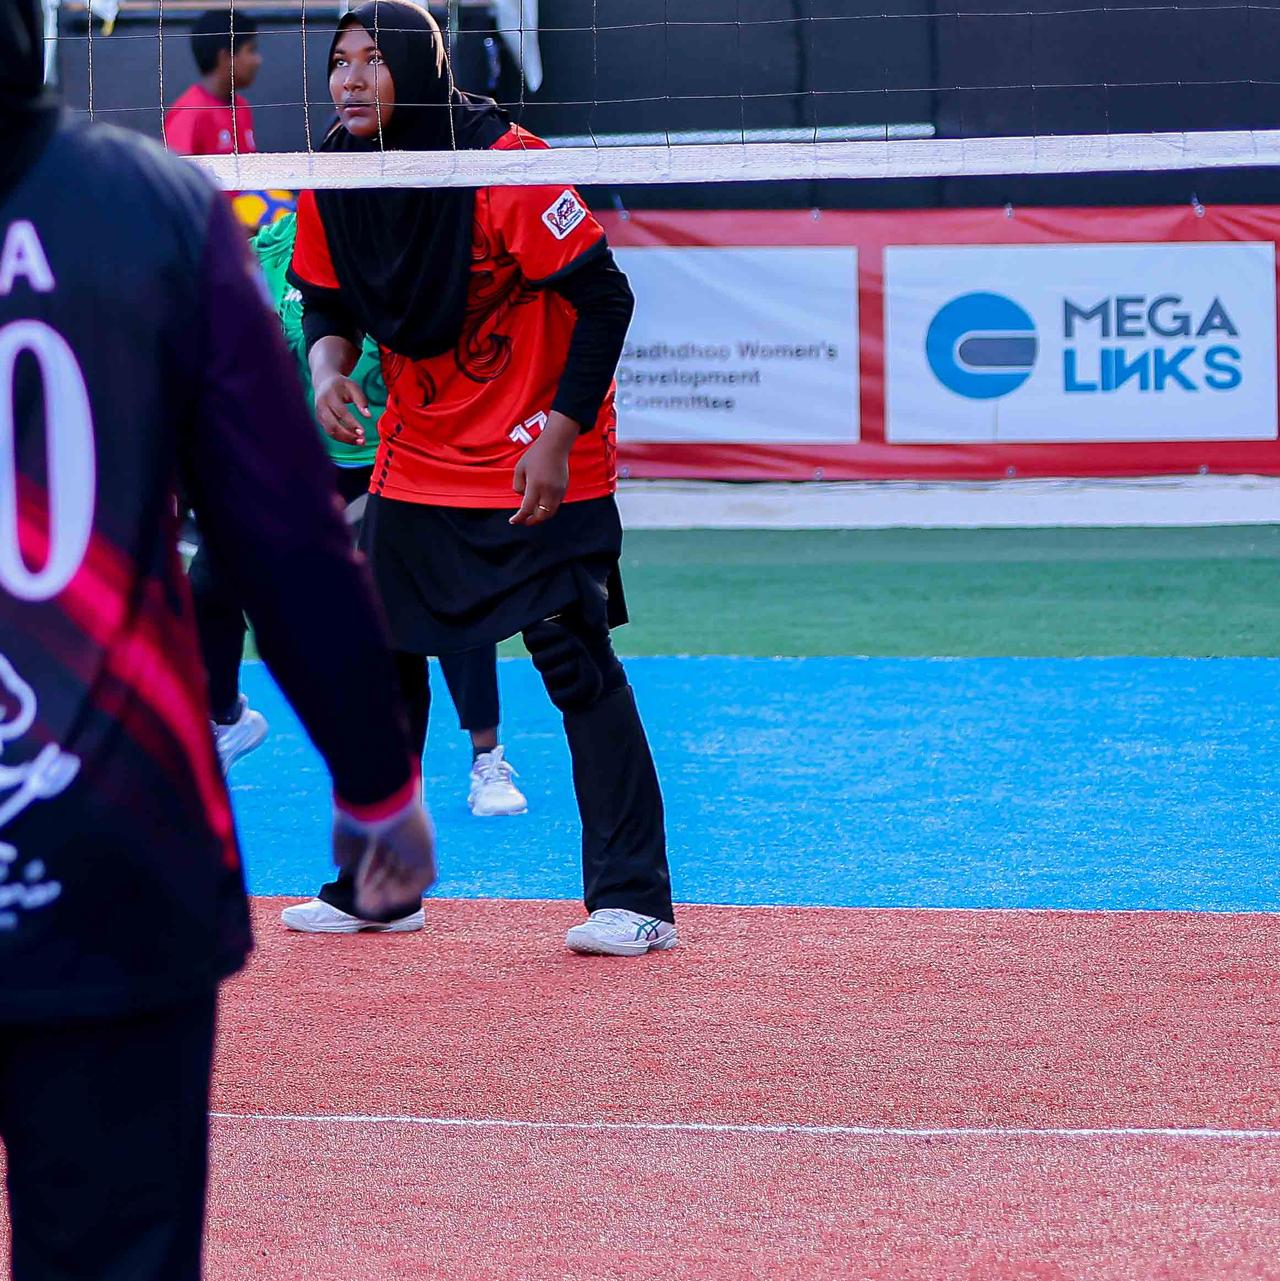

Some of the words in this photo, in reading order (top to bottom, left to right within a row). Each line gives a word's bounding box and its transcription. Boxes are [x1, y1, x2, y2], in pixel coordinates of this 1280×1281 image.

[1063, 296, 1238, 338] MEGA
[737, 340, 838, 360] Women's
[619, 366, 761, 388] Development
[619, 390, 736, 410] Committee
